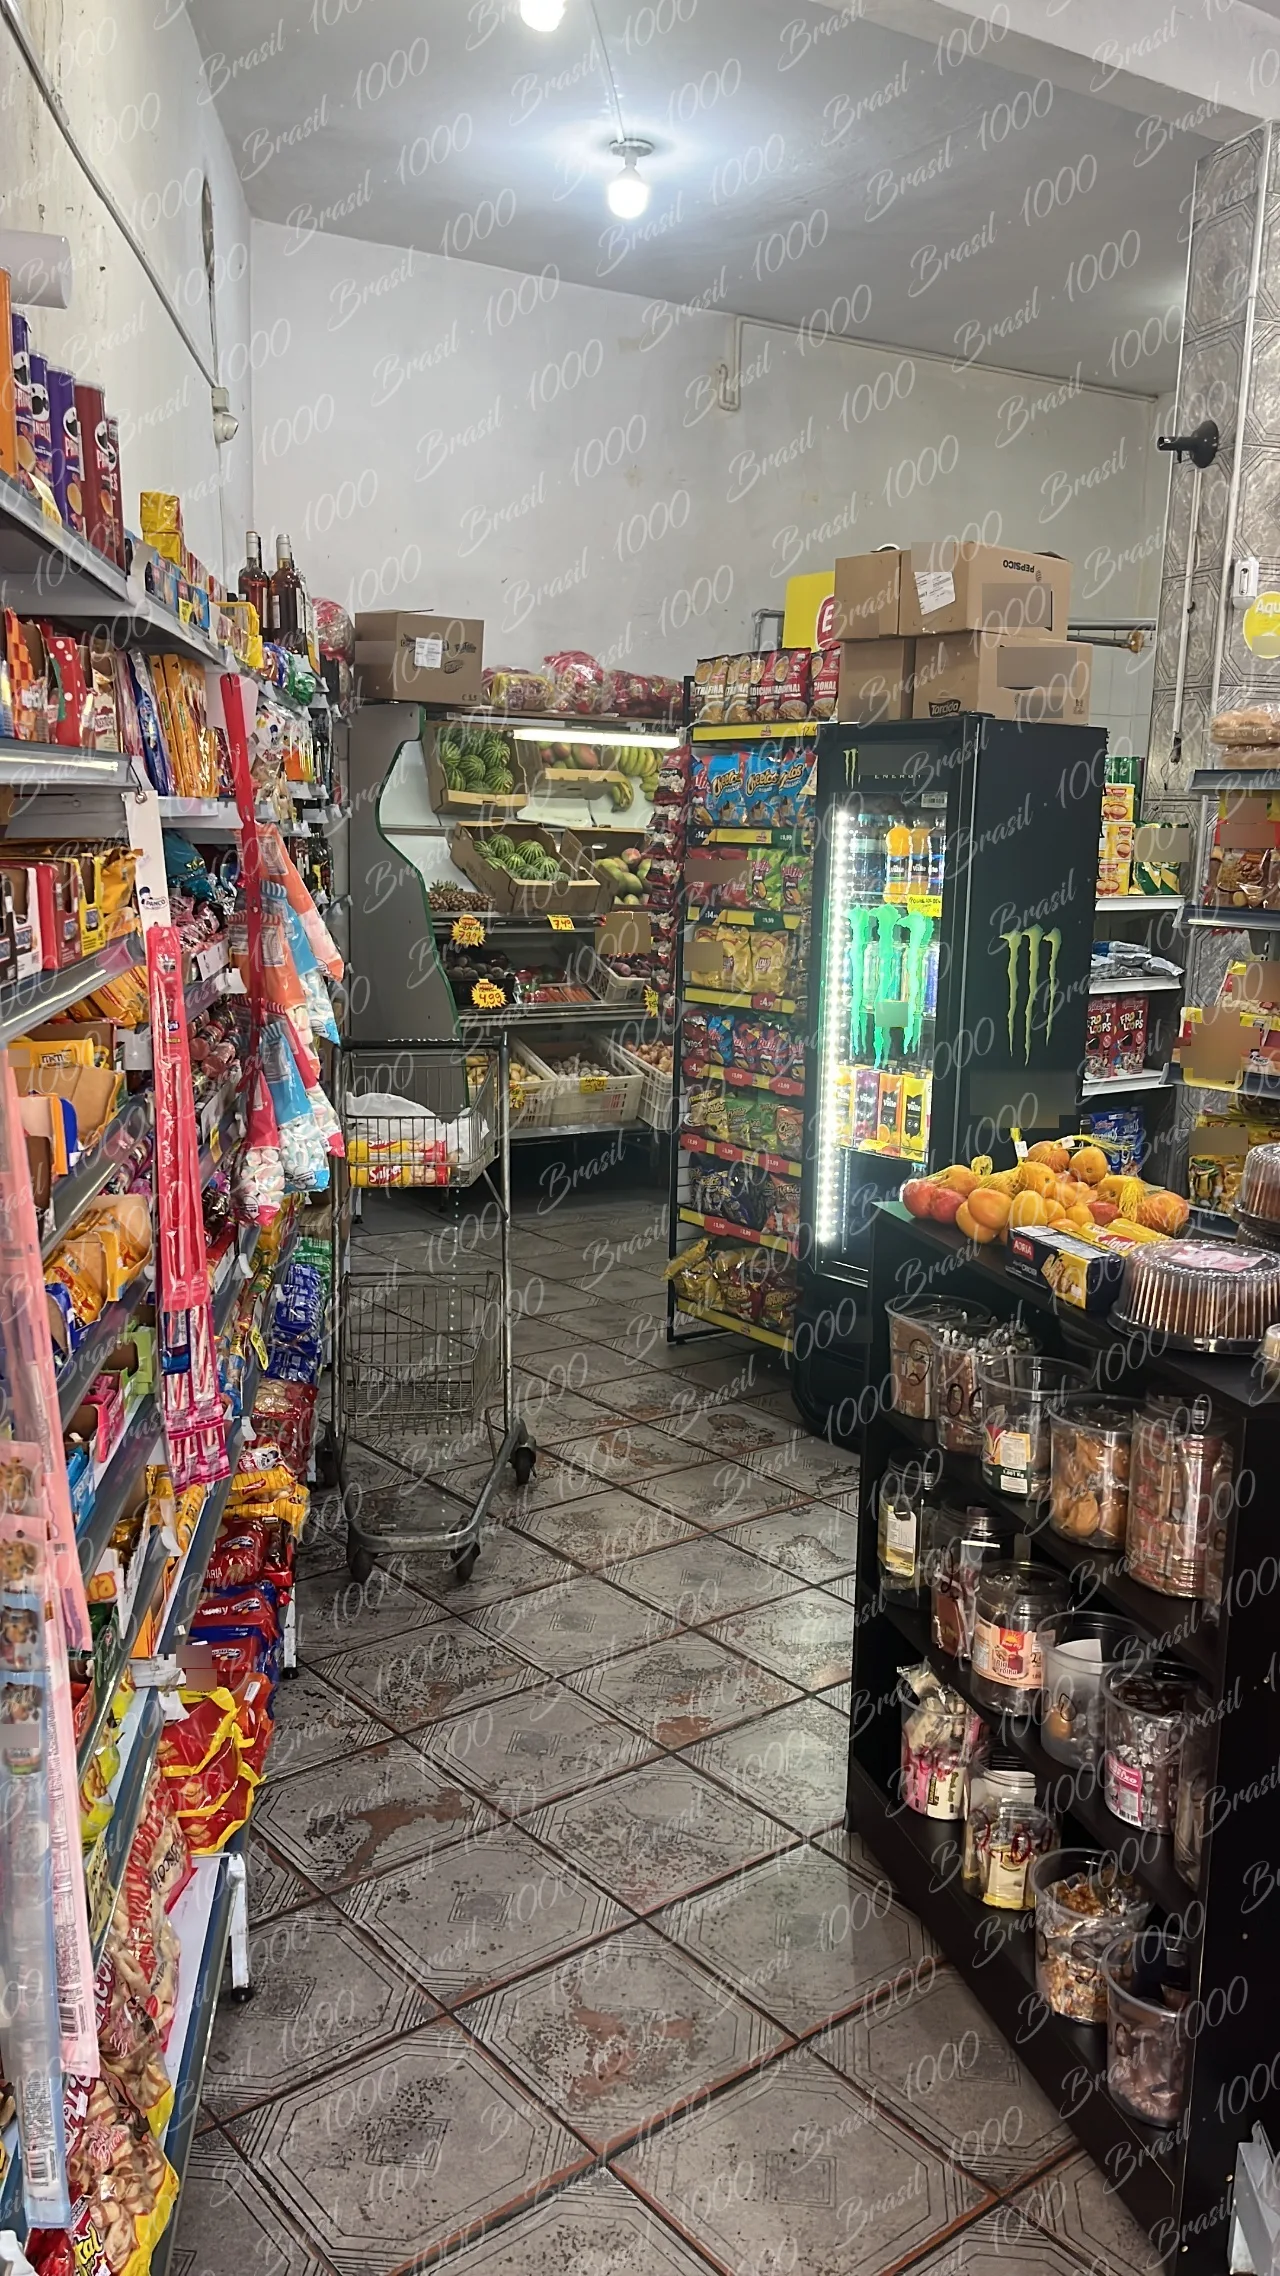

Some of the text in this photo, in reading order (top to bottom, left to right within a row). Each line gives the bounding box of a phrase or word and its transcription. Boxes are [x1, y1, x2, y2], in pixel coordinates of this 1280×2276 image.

[1003, 560, 1035, 574] PEPSICO
[930, 703, 960, 714] Torcida
[146, 898, 167, 908] PANCO
[1013, 1239, 1033, 1256] ADRIA
